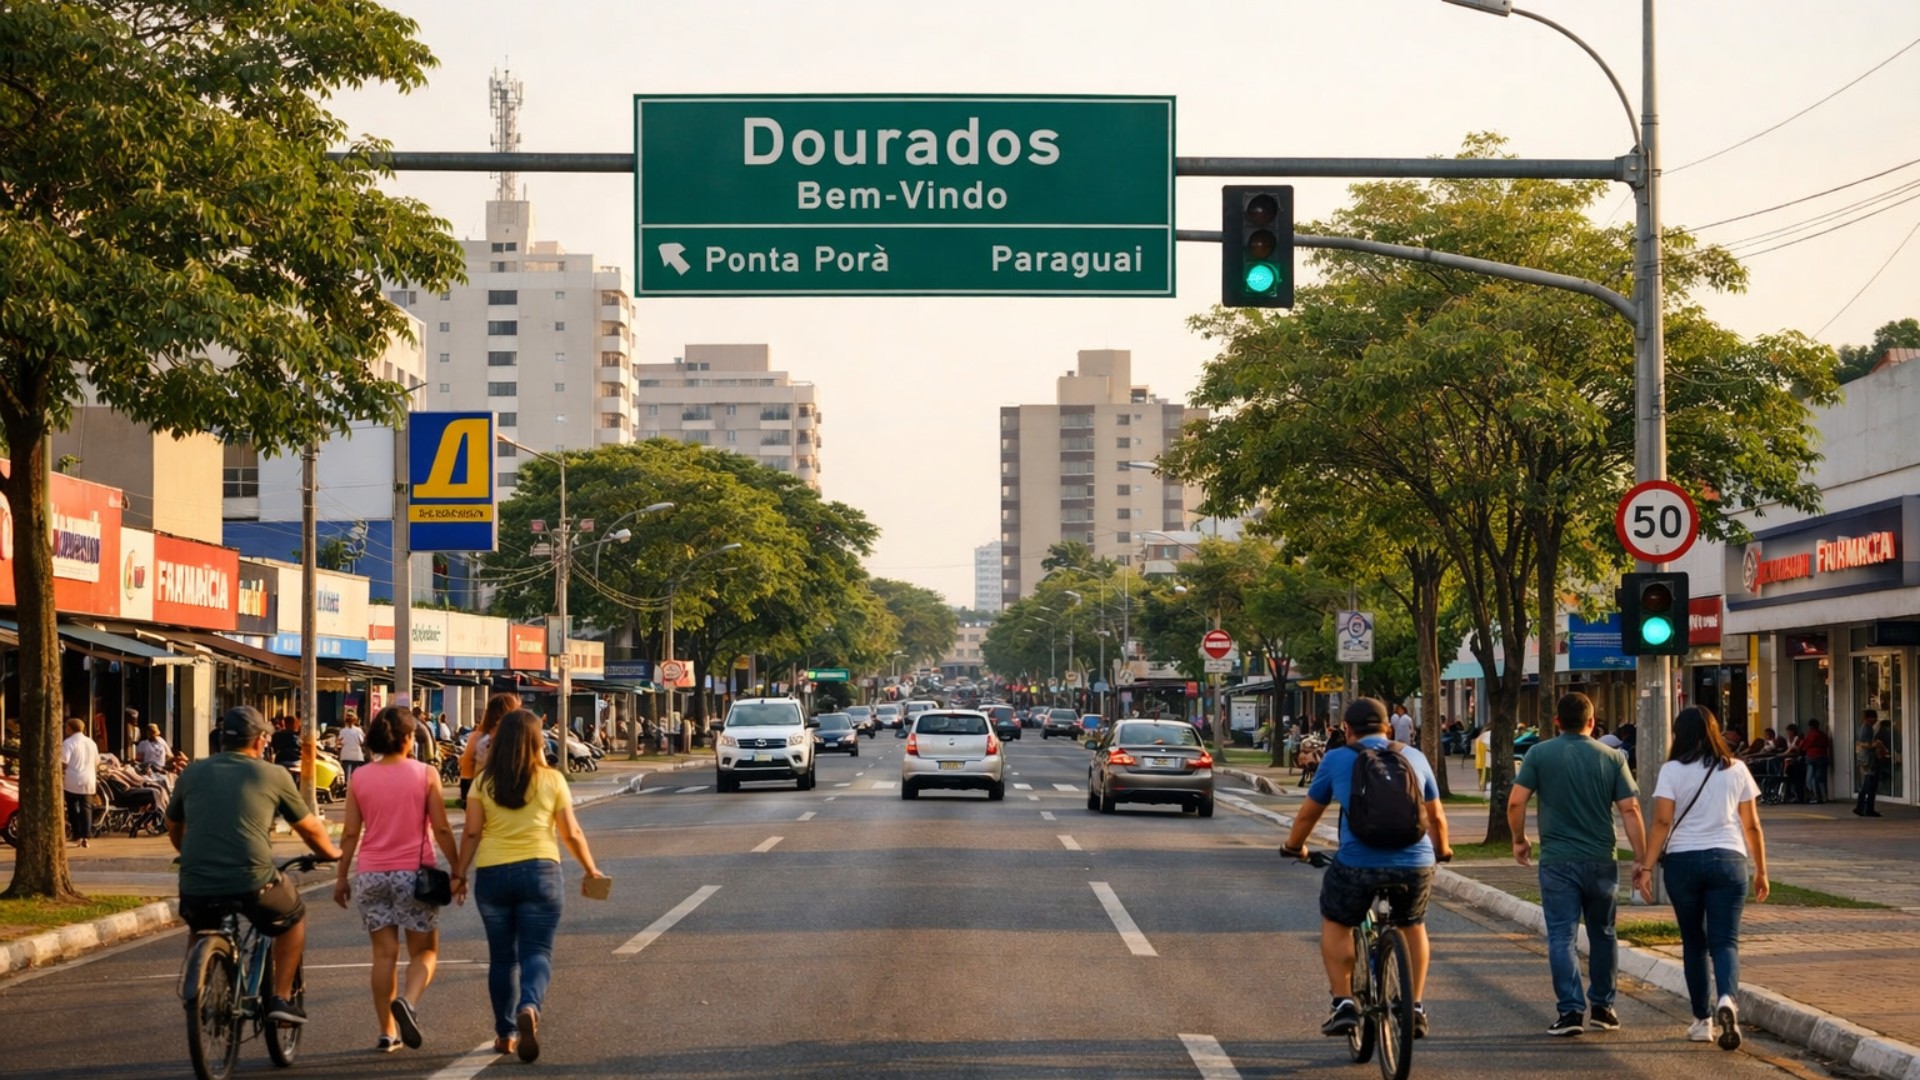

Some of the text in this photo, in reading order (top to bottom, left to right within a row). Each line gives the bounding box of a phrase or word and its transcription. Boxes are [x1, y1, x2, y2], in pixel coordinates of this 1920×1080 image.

[744, 116, 1060, 166] Dourados
[798, 180, 1008, 210] Bem-Vindo
[706, 243, 889, 272] Ponta Porà
[992, 245, 1142, 278] Paraguai
[1634, 505, 1682, 538] 50
